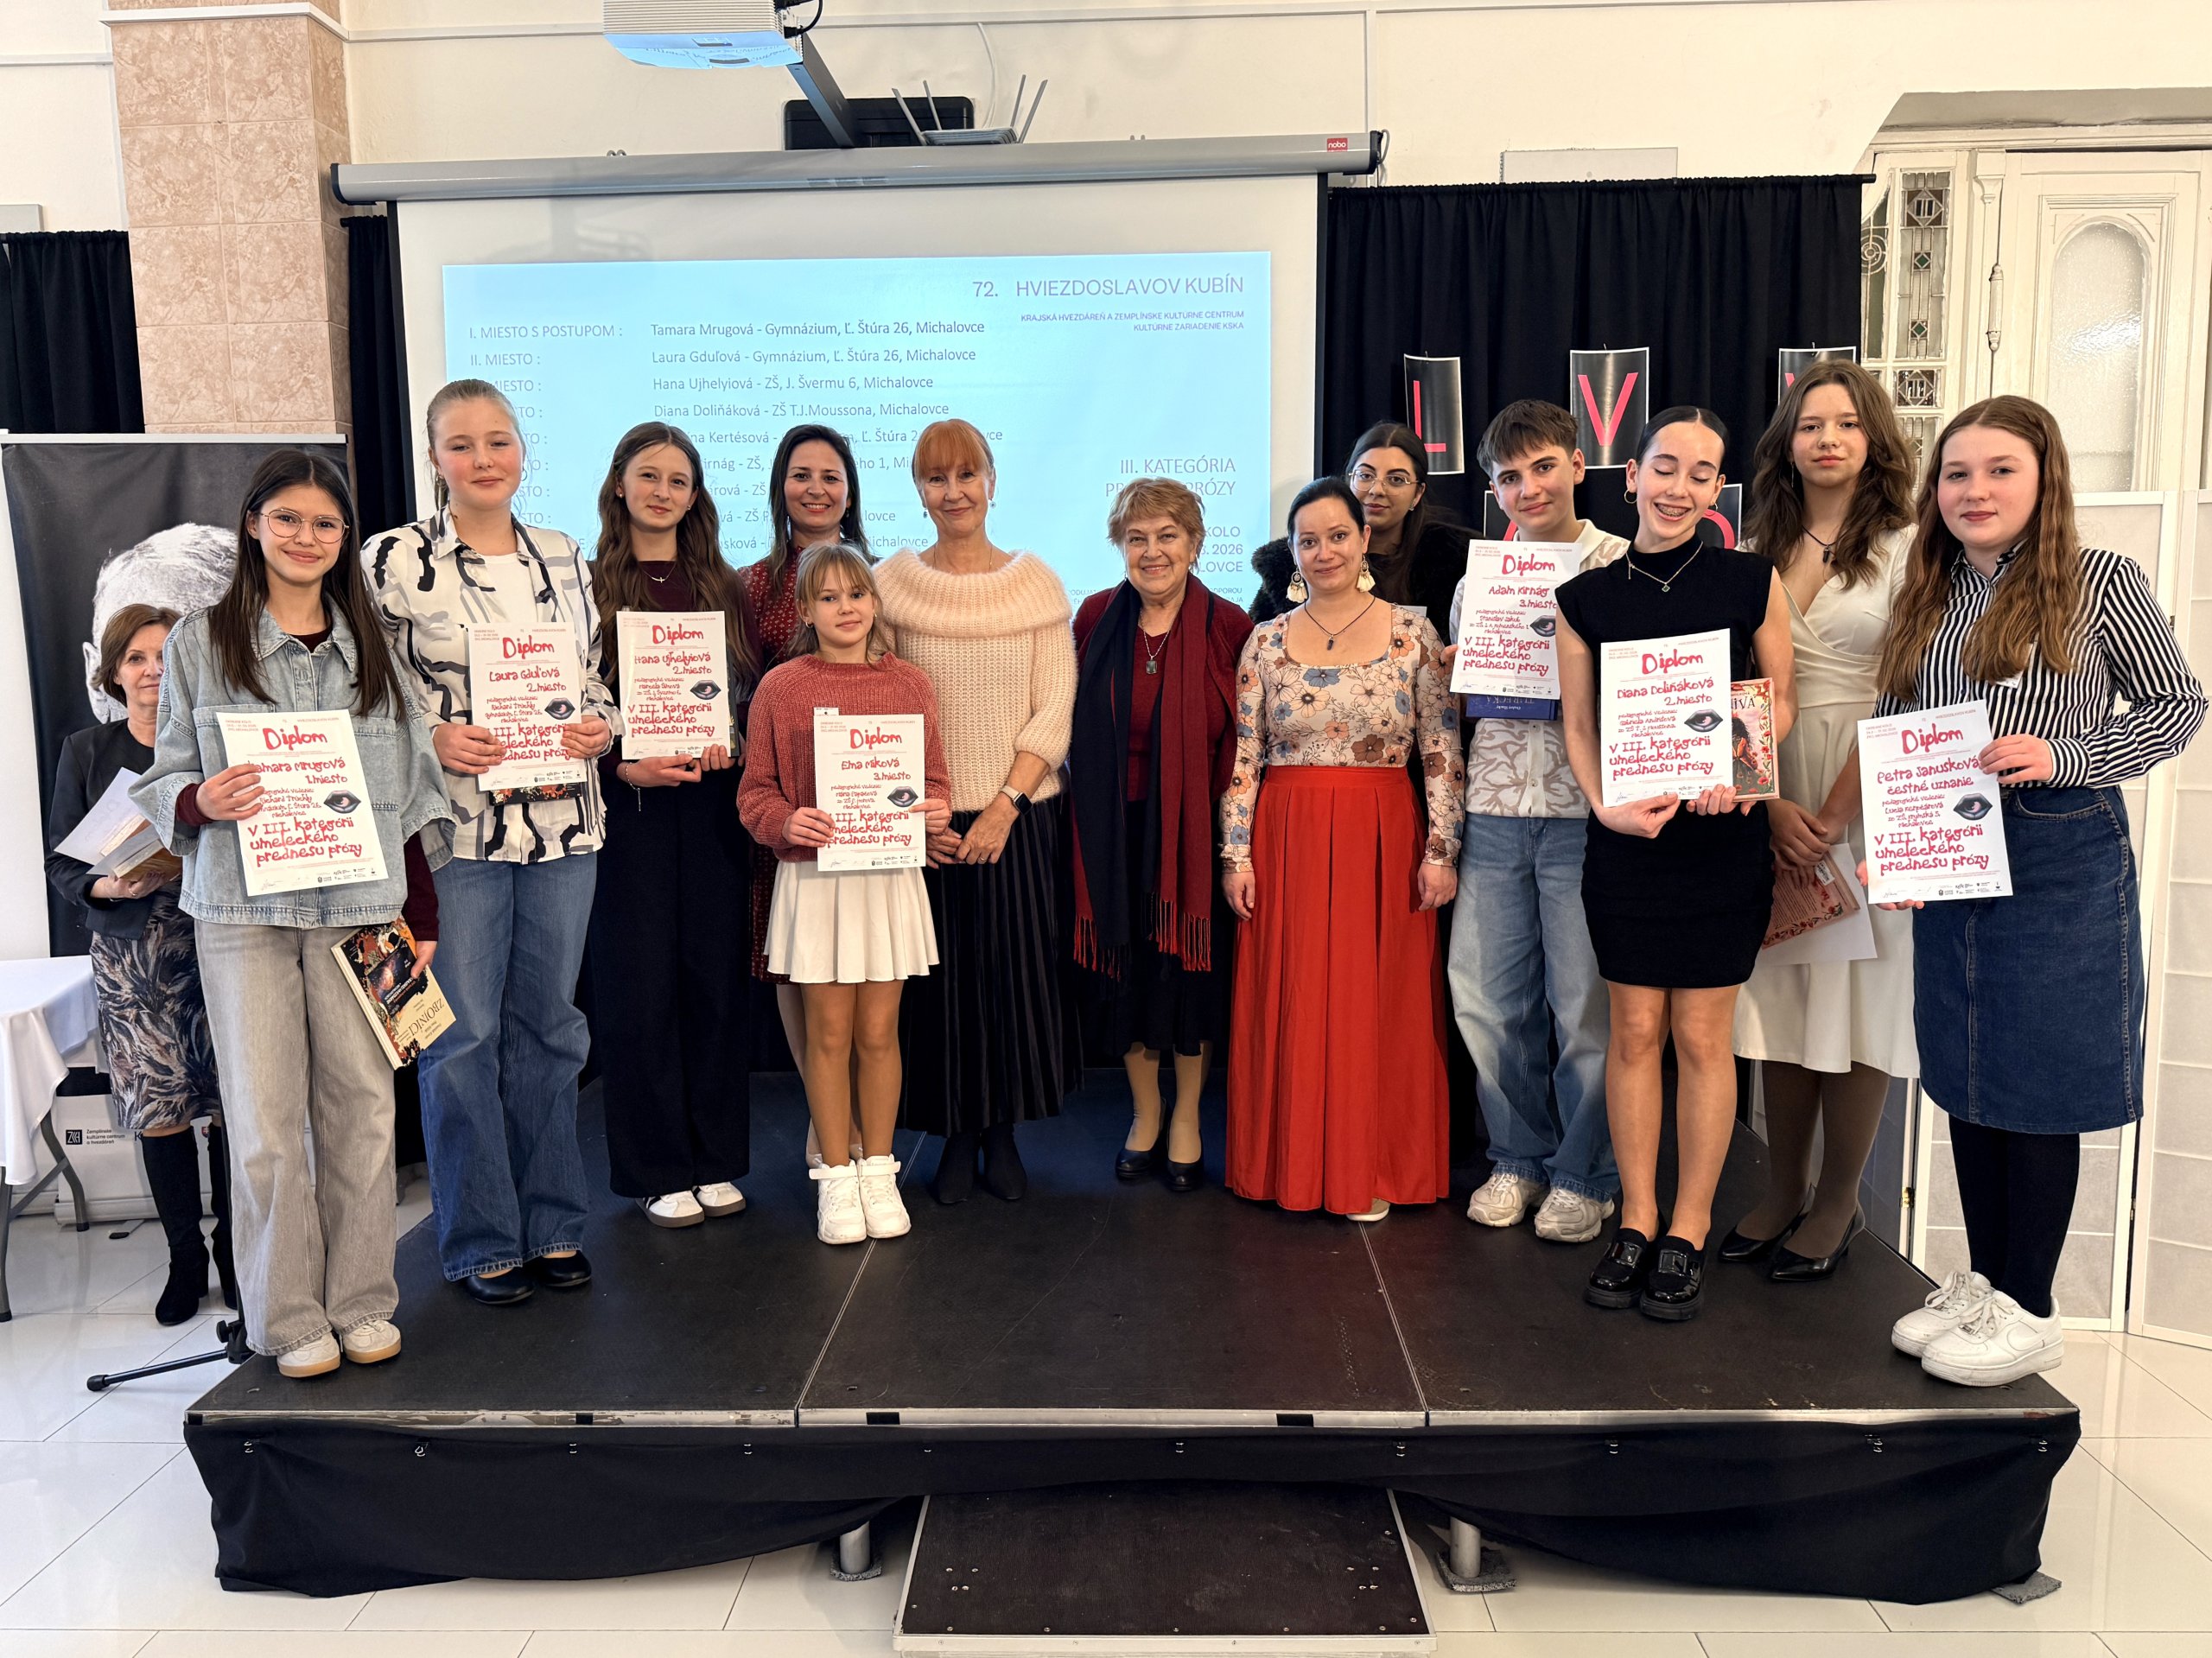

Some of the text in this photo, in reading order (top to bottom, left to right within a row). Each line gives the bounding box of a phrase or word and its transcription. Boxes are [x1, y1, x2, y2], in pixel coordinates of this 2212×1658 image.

[972, 273, 1243, 297] 72. HVIEZDOSLAVOV KUBÍN
[1021, 312, 1057, 321] KRAJSKÁ
[1058, 311, 1106, 321] HVEZDÁREŇ
[1115, 311, 1162, 320] ZEMPLÍNSKE
[1205, 310, 1244, 319] CENTRUM
[469, 324, 614, 339] I. MIESTO S POSTUPOM
[651, 324, 696, 335] Tamara
[700, 323, 753, 338] Mrugová
[765, 322, 841, 338] Gymnázium,
[858, 319, 890, 334] Štúra
[893, 321, 912, 336] 26,
[916, 321, 985, 334] Michalovce
[1175, 321, 1222, 330] ZARIADENIE
[1223, 321, 1244, 330] KSKA
[471, 353, 533, 365] II. MIESTO
[652, 352, 685, 363] Laura
[690, 350, 741, 363] Gduľová
[753, 350, 830, 365] Gymnázium,
[847, 346, 880, 362] Štúra
[883, 349, 902, 364] 26,
[906, 348, 976, 361] Michalovce
[653, 374, 933, 391] Hana Ujhelyiová ZŠ, J. Švermu 6, Michalovce
[654, 401, 949, 417] Diana Doliňáková ZŠ T.J.Moussona, Michalovce
[1578, 372, 1638, 447] V
[709, 431, 769, 443] Kertésová
[874, 428, 906, 442] Štúra
[704, 455, 765, 472] irnág ZŠ,
[1121, 454, 1236, 473] III. KATEGÓRIA
[752, 481, 767, 496] ZŠ
[745, 508, 760, 523] ZŠ
[865, 510, 896, 521] lovce
[1211, 543, 1243, 555] 2026
[1198, 561, 1243, 572] LOVCE
[1502, 553, 1555, 576] Diplom
[1488, 585, 1550, 598] Adam Kirnág
[652, 623, 704, 645] Diplom
[502, 635, 555, 659] Diplom
[1475, 636, 1495, 646] III.
[1498, 634, 1550, 651] kategórii
[634, 651, 711, 666] Hana Ujhelyiová
[1462, 645, 1532, 661] umeleckého
[1463, 658, 1549, 677] prednesu prózy
[1642, 649, 1703, 675] Diplom
[489, 671, 518, 683] Laura
[1617, 688, 1649, 699] Diana
[639, 704, 659, 714] III.
[663, 701, 712, 715] kategórii
[628, 710, 697, 725] umeleckého
[518, 722, 568, 737] kategór
[632, 724, 715, 739] prednesu prózy
[263, 725, 327, 751] Diplom
[500, 732, 554, 750] eleckého
[849, 727, 902, 750] Diplom
[1622, 741, 1646, 753] III.
[1650, 735, 1711, 750] kategórii
[1901, 722, 1964, 754] Diplom
[502, 749, 541, 761] dnesu
[1609, 746, 1691, 765] umeleckého
[251, 761, 292, 773] amara
[841, 760, 863, 771] Ema
[1612, 760, 1713, 781] prednesu prózy
[1877, 768, 1913, 785] Petra
[1887, 776, 1974, 795] čestné uznanie
[294, 816, 354, 831] kategórii
[860, 809, 909, 823] kategórii
[830, 819, 893, 835] meleckého
[1889, 831, 1916, 844] III.
[1920, 824, 1983, 842] kategórii
[250, 828, 339, 850] umeleckého
[882, 833, 912, 847] prózy
[256, 843, 362, 867] prednesu prózy
[1875, 838, 1965, 859] umeleckého
[1880, 854, 1989, 876] prednesu prózy
